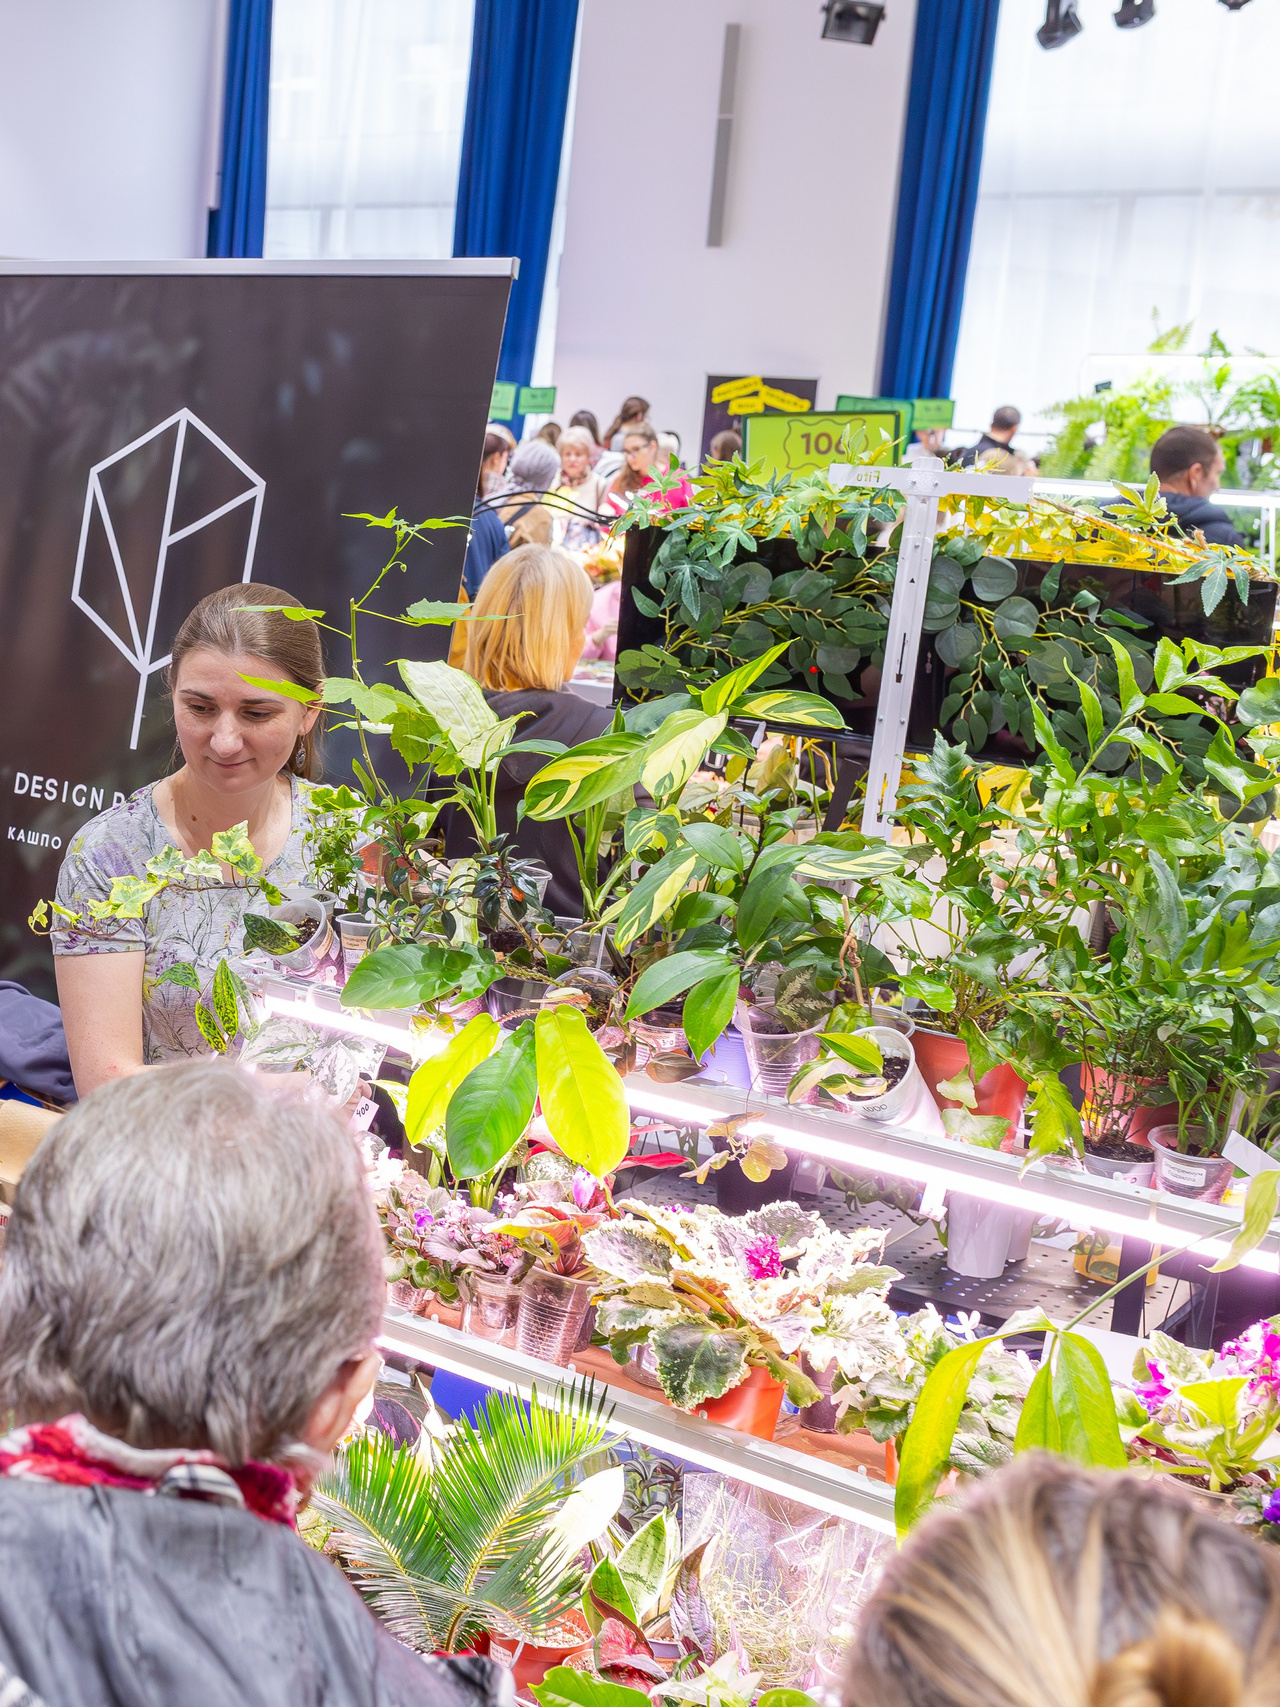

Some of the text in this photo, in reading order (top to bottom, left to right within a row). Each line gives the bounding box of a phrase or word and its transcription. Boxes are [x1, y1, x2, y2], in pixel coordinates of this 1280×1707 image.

[13, 771, 126, 811] DESIGN P
[7, 825, 62, 850] КАШПО
[355, 1103, 370, 1118] 400
